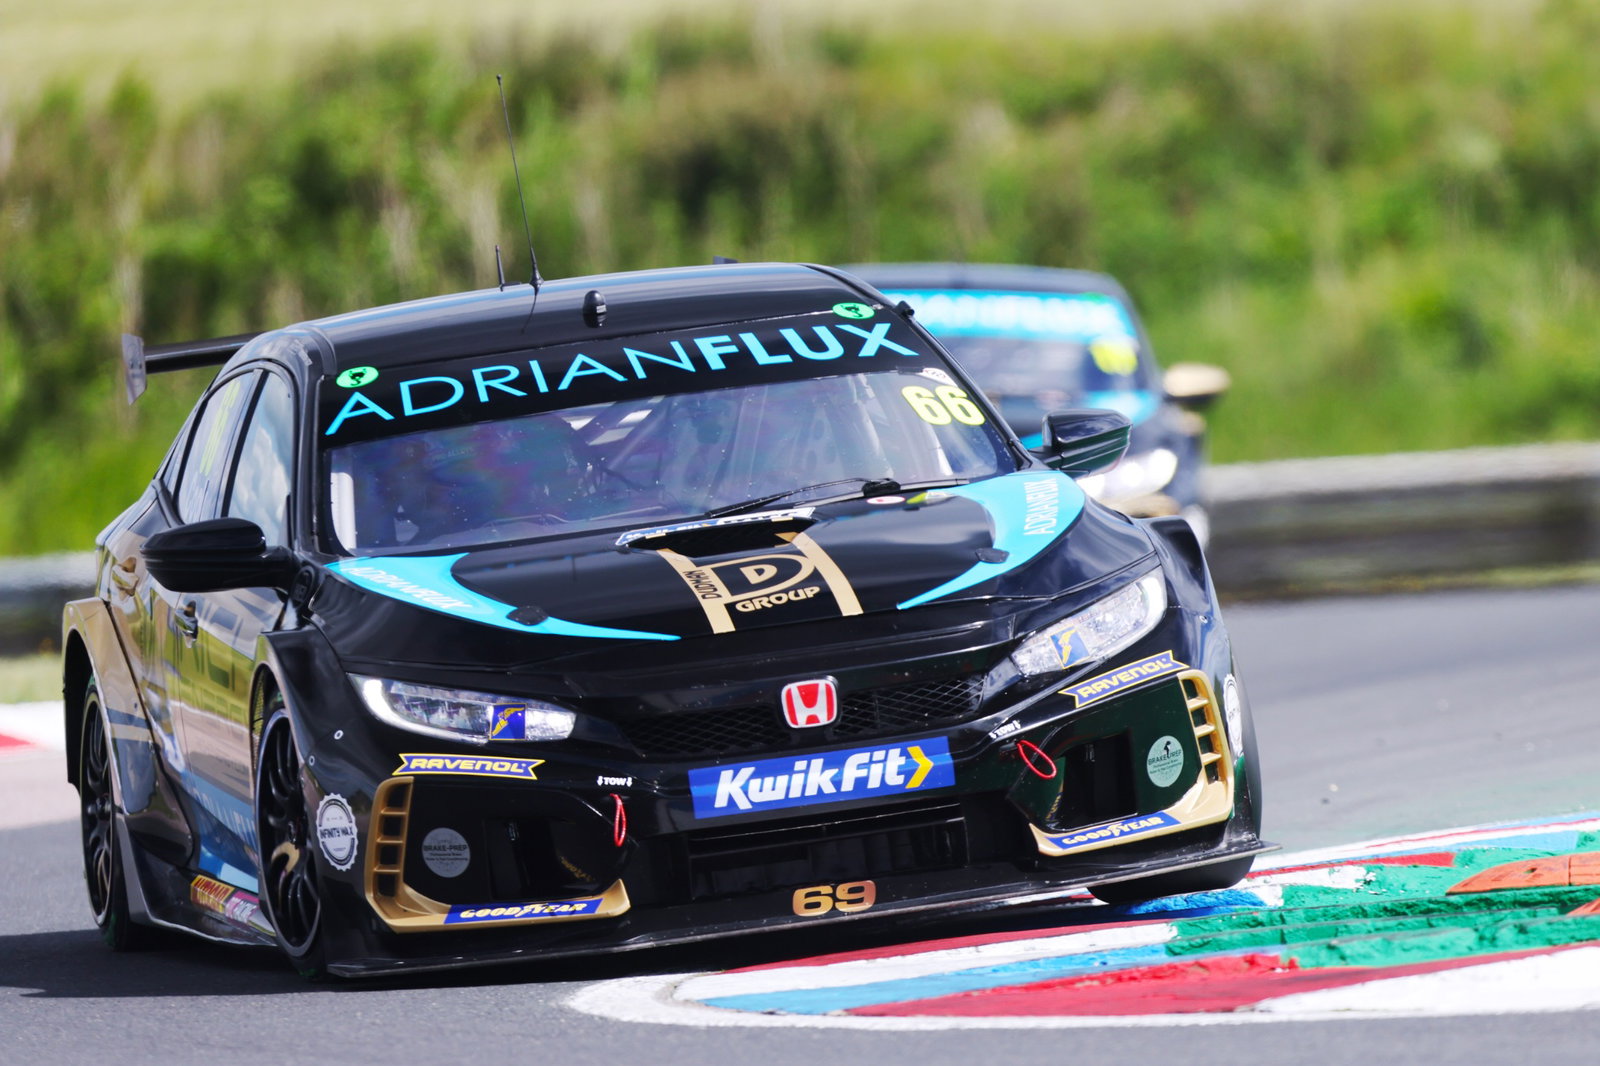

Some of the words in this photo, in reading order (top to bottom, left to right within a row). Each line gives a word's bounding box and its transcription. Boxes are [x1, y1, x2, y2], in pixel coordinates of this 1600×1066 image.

[902, 386, 985, 425] 66
[735, 585, 821, 613] GROUP
[1076, 658, 1169, 699] RAVENOL
[409, 758, 526, 773] RAVENOL
[603, 776, 627, 786] TOW
[1062, 816, 1165, 845] GOODYEAR
[460, 901, 587, 919] GOODYEAR
[792, 880, 877, 917] 69
